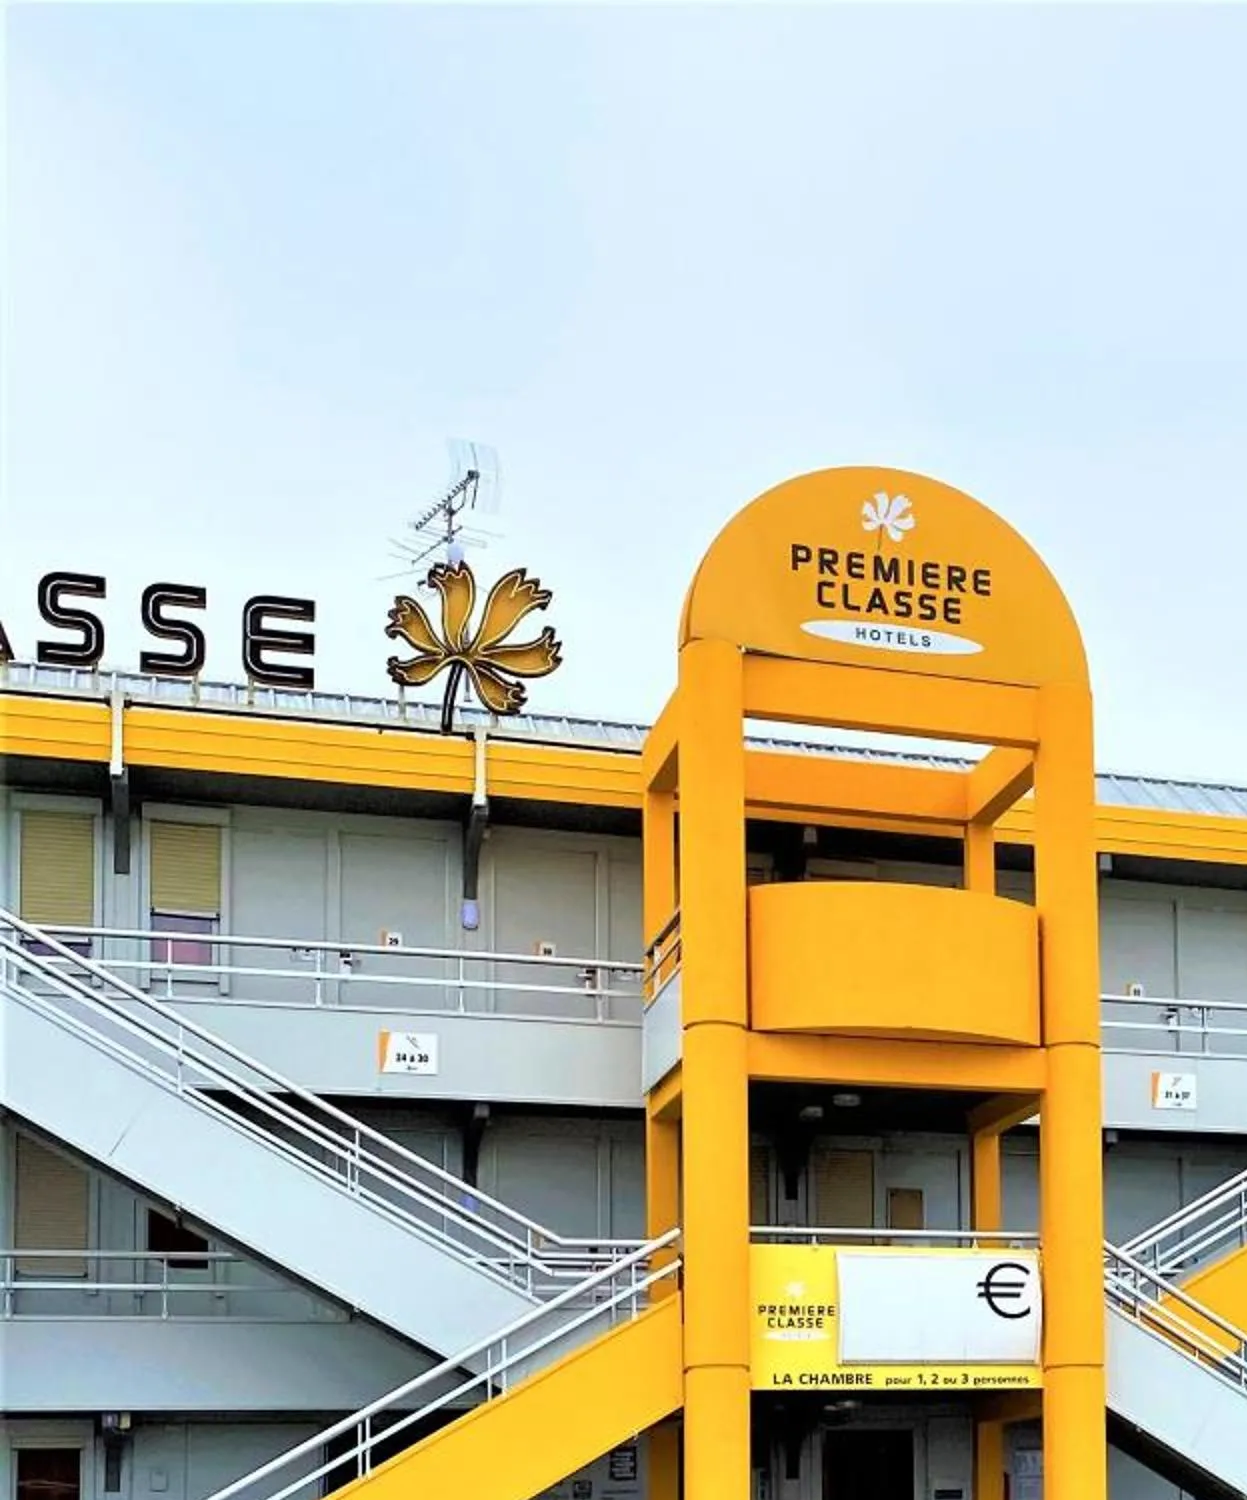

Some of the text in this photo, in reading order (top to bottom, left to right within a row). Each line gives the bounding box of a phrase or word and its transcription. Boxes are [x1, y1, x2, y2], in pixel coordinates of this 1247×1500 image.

[791, 543, 991, 597] PREMIERE
[816, 581, 963, 625] CLASSE
[0, 571, 316, 688] SSE
[855, 626, 932, 648] HOTELS
[757, 1304, 836, 1317] PREMIERE
[767, 1317, 824, 1329] CLASSE
[773, 1373, 793, 1386] LA
[798, 1373, 873, 1386] CHAMBRE
[885, 1376, 912, 1387] pour
[931, 1373, 939, 1386] 2
[943, 1377, 957, 1385] ou
[961, 1373, 969, 1385] 3
[973, 1375, 1030, 1387] personnes
